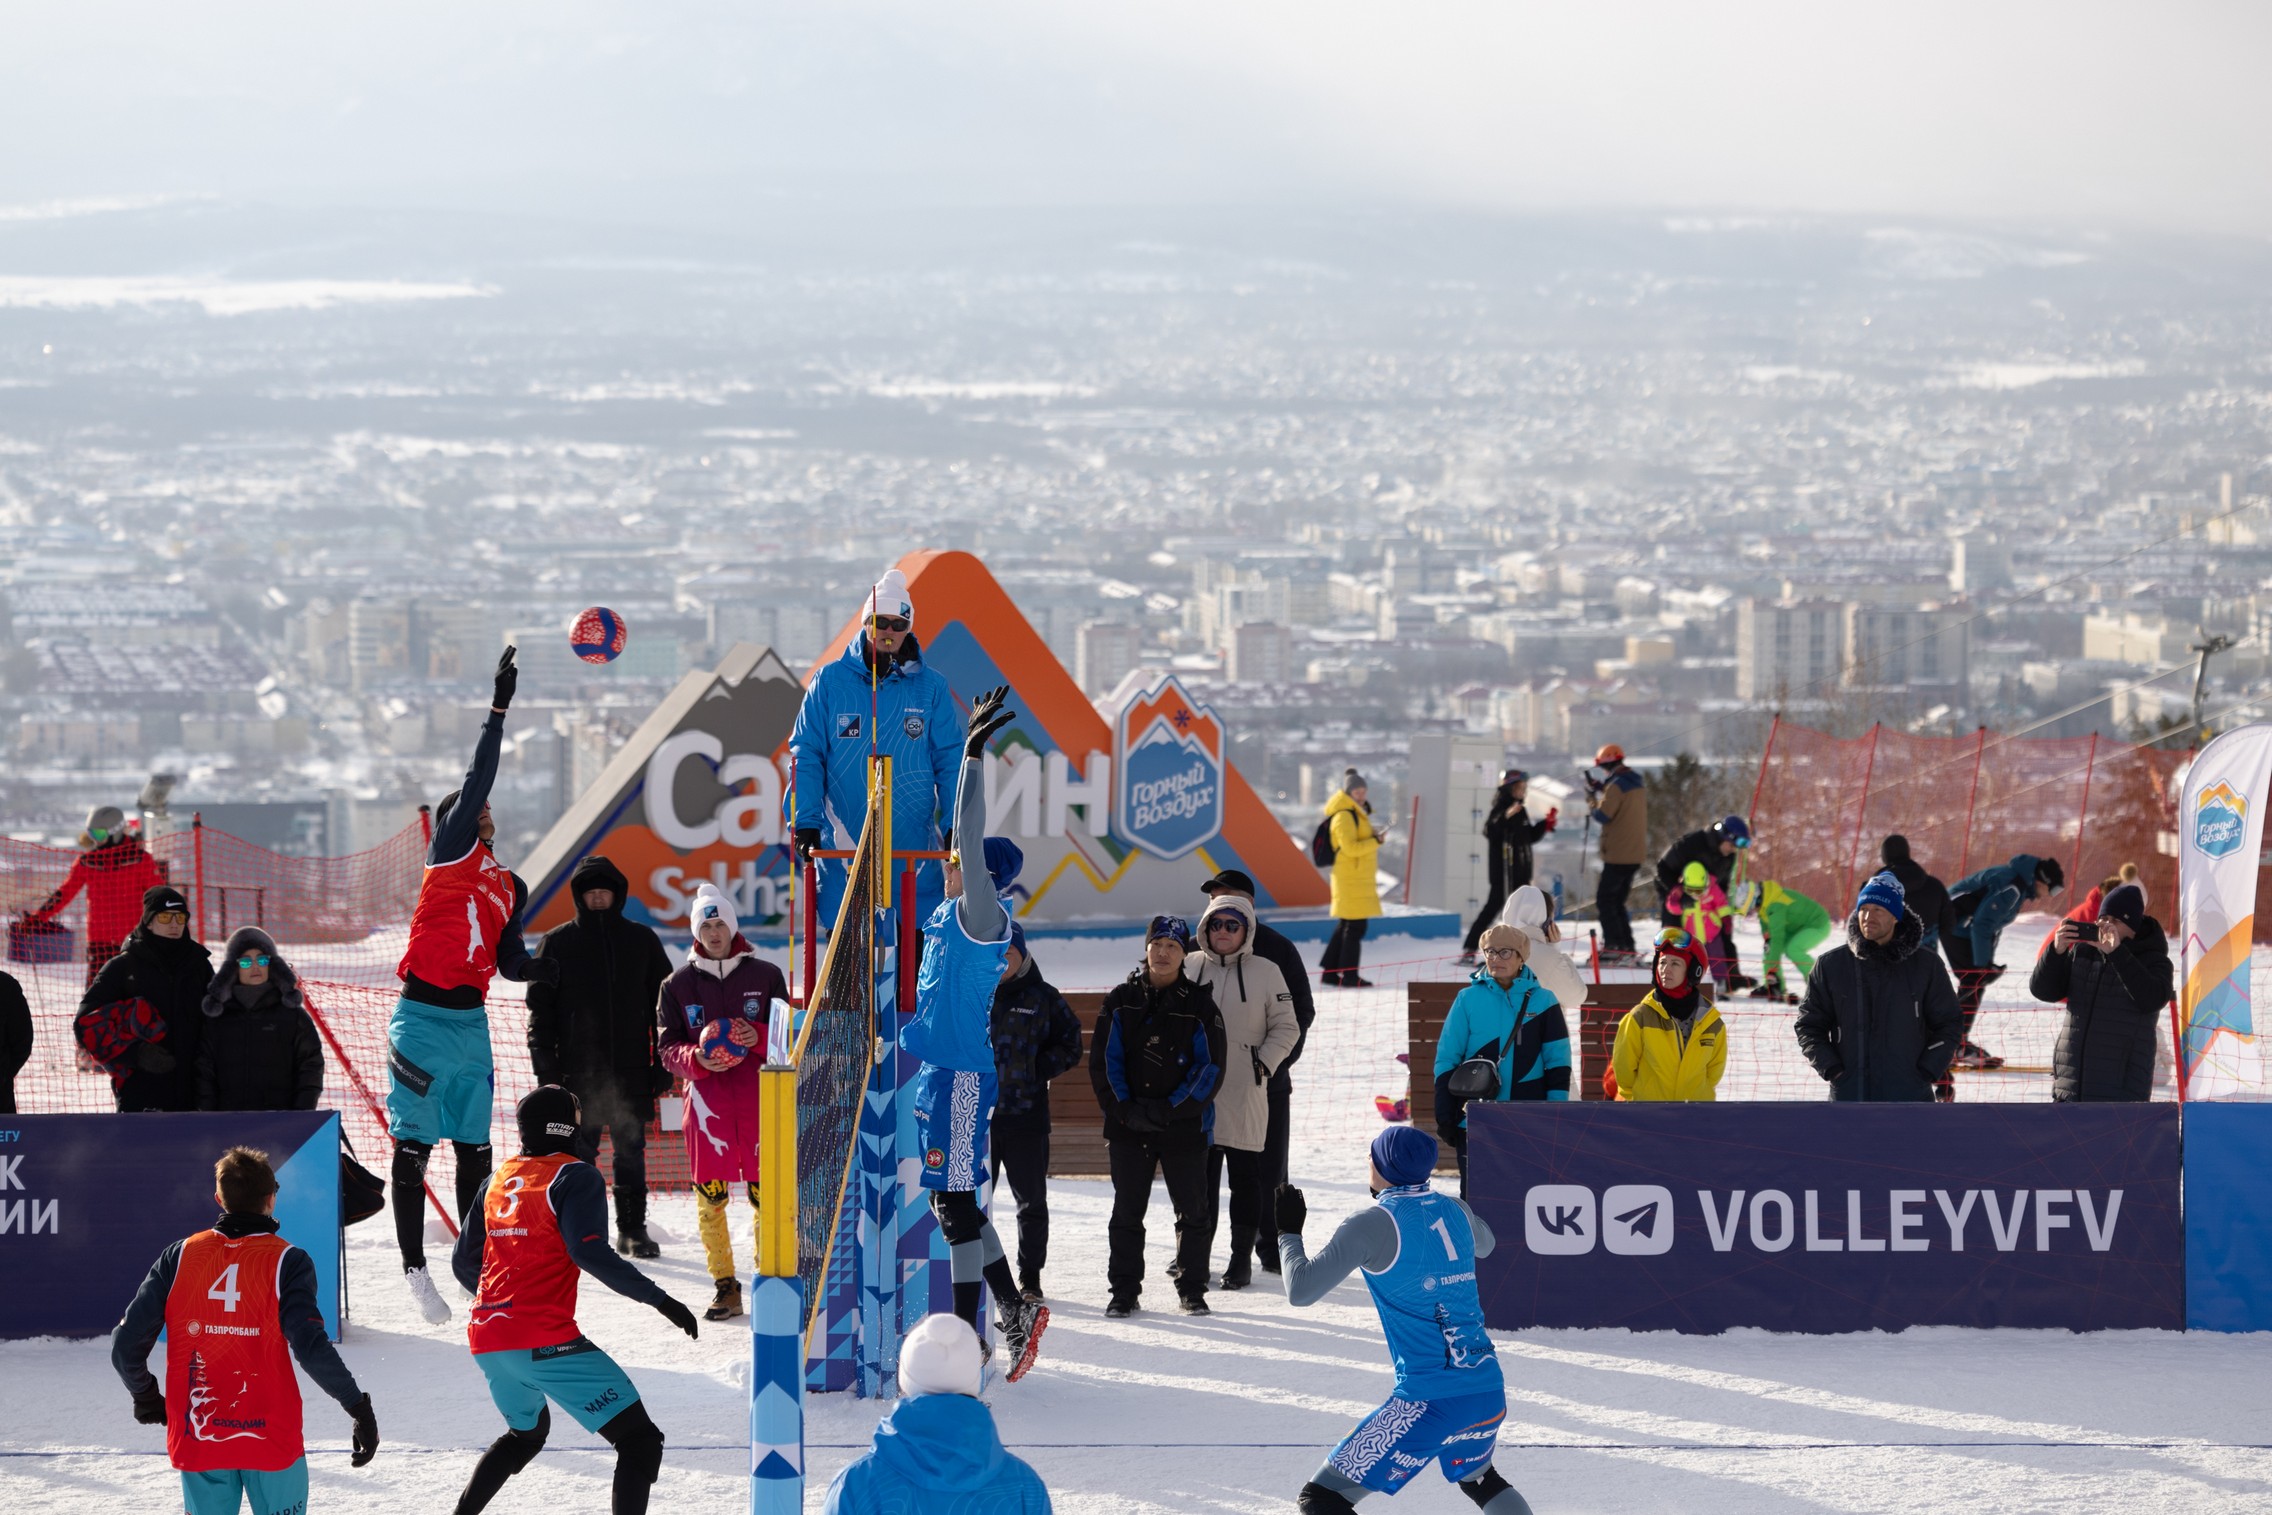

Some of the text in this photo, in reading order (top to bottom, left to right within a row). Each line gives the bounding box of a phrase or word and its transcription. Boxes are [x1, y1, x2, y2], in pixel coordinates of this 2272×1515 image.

[496, 1176, 525, 1219] 3
[1429, 1216, 1459, 1262] 1
[1697, 1189, 2124, 1253] VOLLEYVFV
[207, 1263, 241, 1313] 4
[204, 1324, 260, 1337] ГАЗПРОМБАНК
[583, 1387, 620, 1416] MAKS
